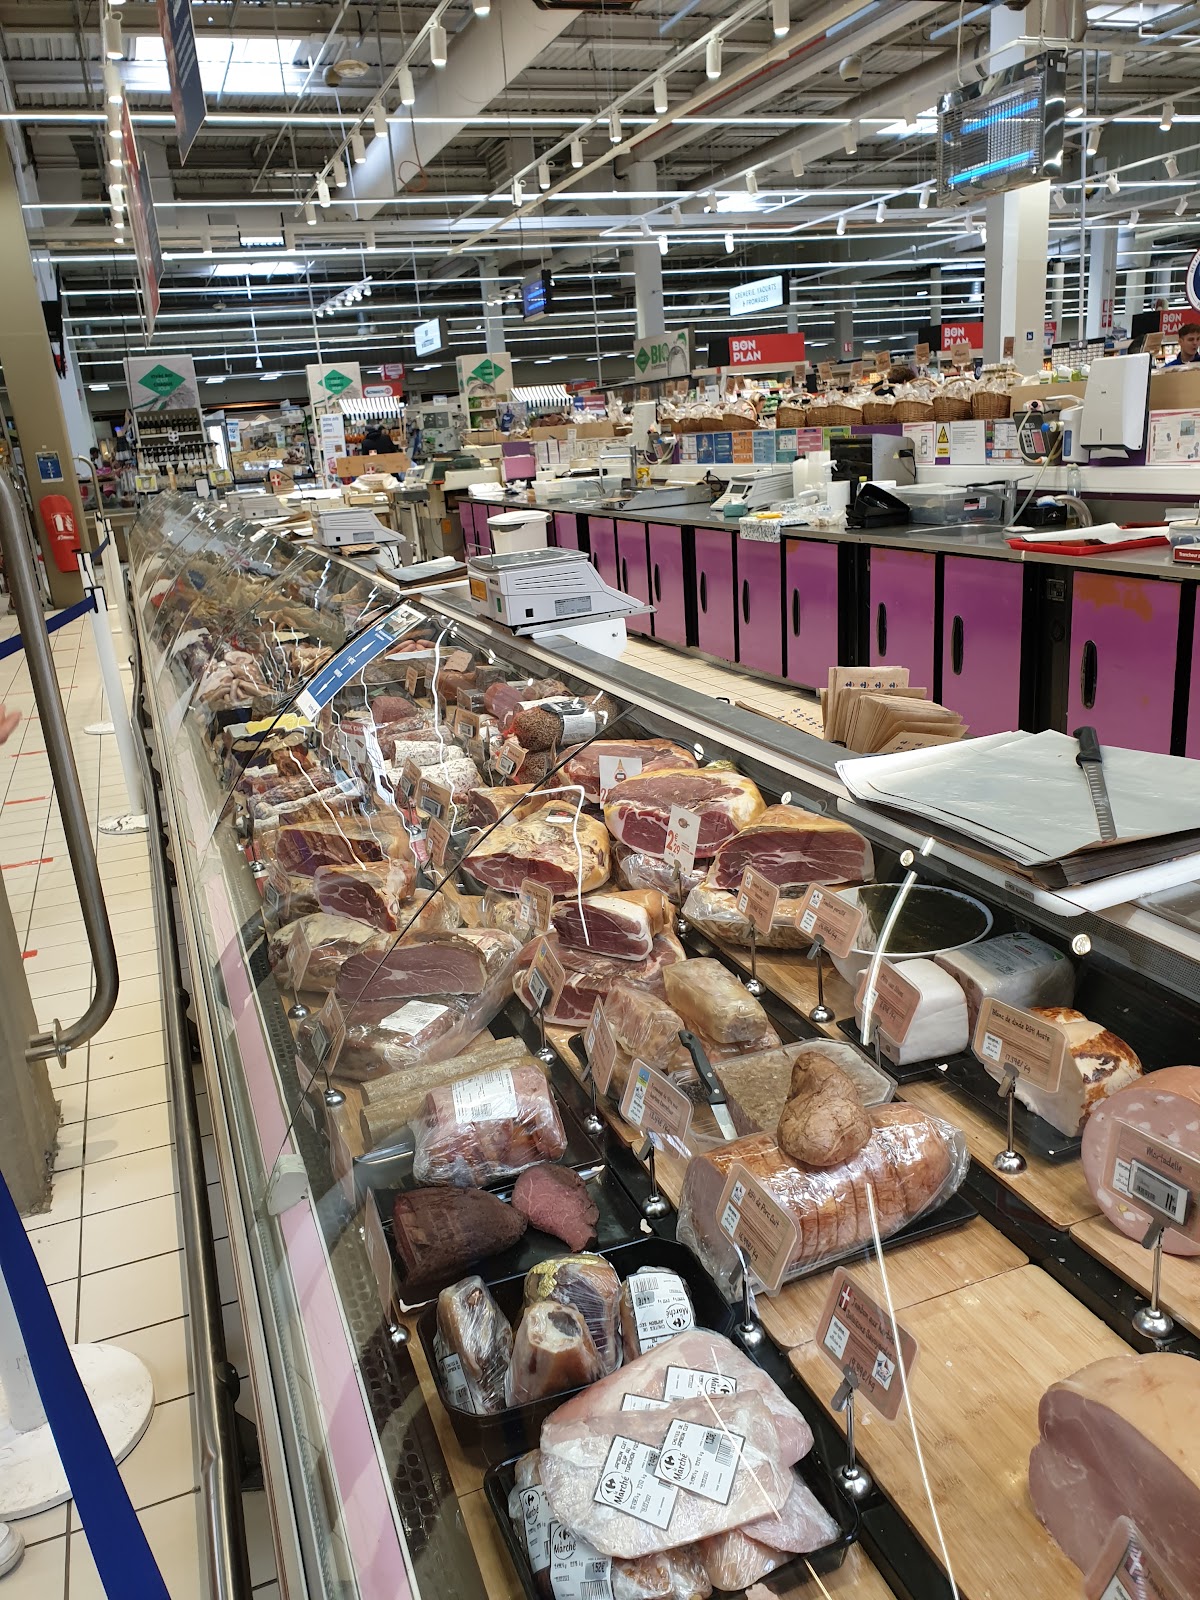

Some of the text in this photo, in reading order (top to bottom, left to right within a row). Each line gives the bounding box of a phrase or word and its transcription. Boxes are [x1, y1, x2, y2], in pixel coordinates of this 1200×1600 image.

[1162, 313, 1182, 323] BON
[944, 327, 964, 338] BON
[650, 342, 669, 364] BIO
[732, 340, 756, 351] BON
[733, 351, 762, 363] PLAN
[991, 1008, 1004, 1020] Blanc
[1011, 1017, 1024, 1029] dinde
[1146, 1146, 1182, 1173] Mortadelle
[755, 1196, 761, 1207] de
[760, 1202, 771, 1218] Porc
[769, 1213, 779, 1227] Cuit
[664, 1306, 689, 1318] Marché
[851, 1297, 868, 1319] Jambon
[868, 1315, 877, 1328] aux
[614, 1451, 624, 1469] JAMBON
[625, 1451, 635, 1473] TORCHON
[673, 1453, 688, 1481] Marché
[614, 1476, 629, 1505] Marché
[553, 1540, 577, 1554] Marché
